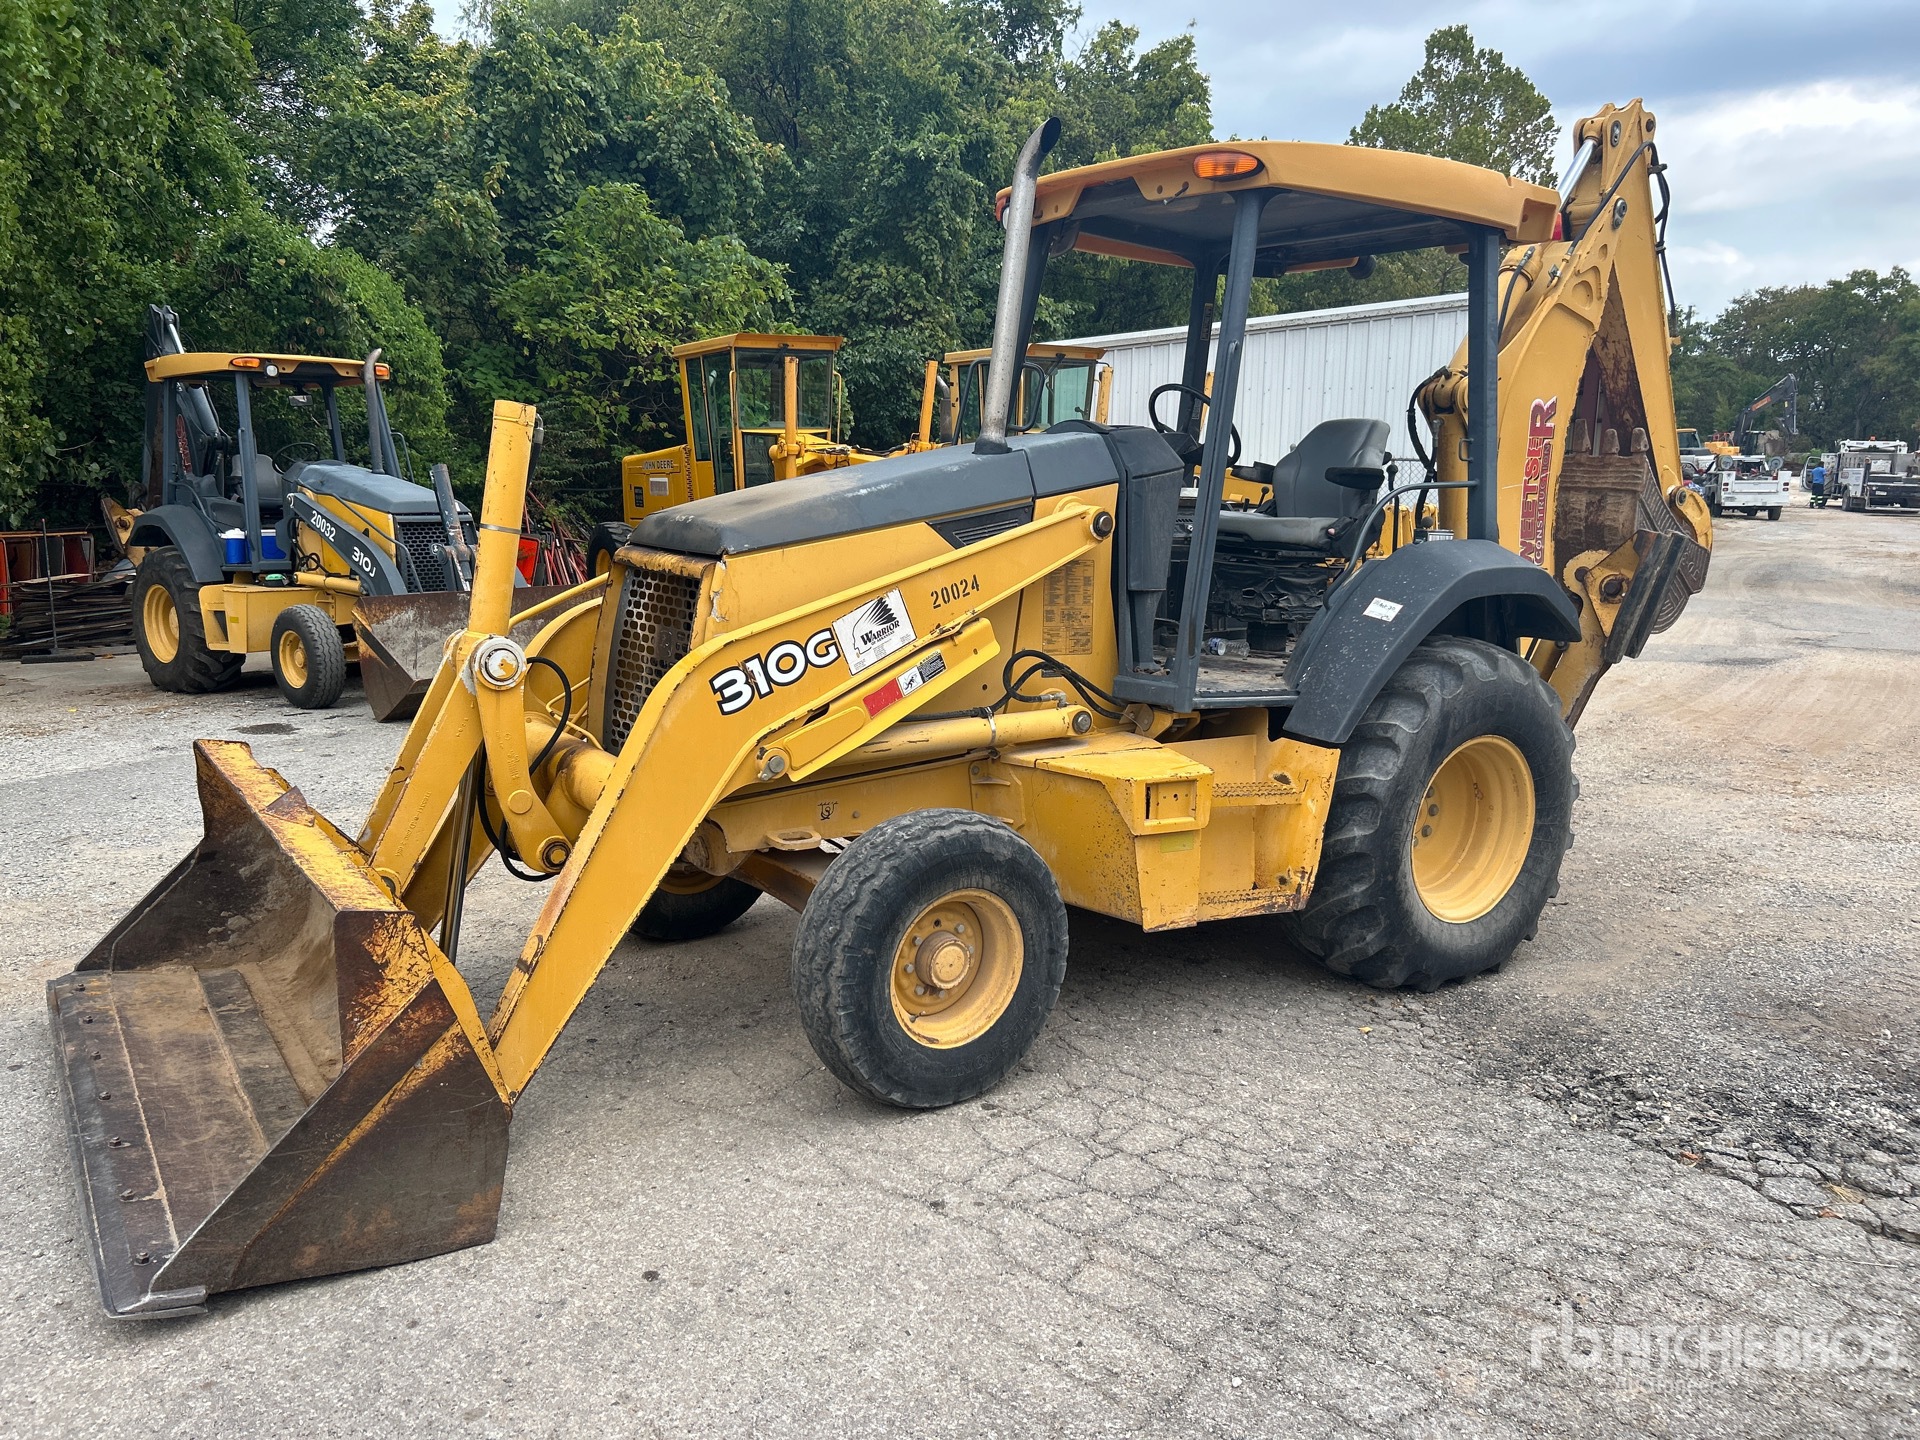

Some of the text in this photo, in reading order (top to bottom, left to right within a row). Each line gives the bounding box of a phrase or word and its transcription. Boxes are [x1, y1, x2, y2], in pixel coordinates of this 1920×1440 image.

[657, 459, 674, 469] DEERE
[1519, 396, 1557, 564] WEETSER
[1535, 444, 1551, 560] CONSTRUCION
[310, 510, 336, 542] 20032
[352, 546, 376, 578] 310J
[930, 574, 980, 609] 20024
[708, 627, 842, 716] 310G
